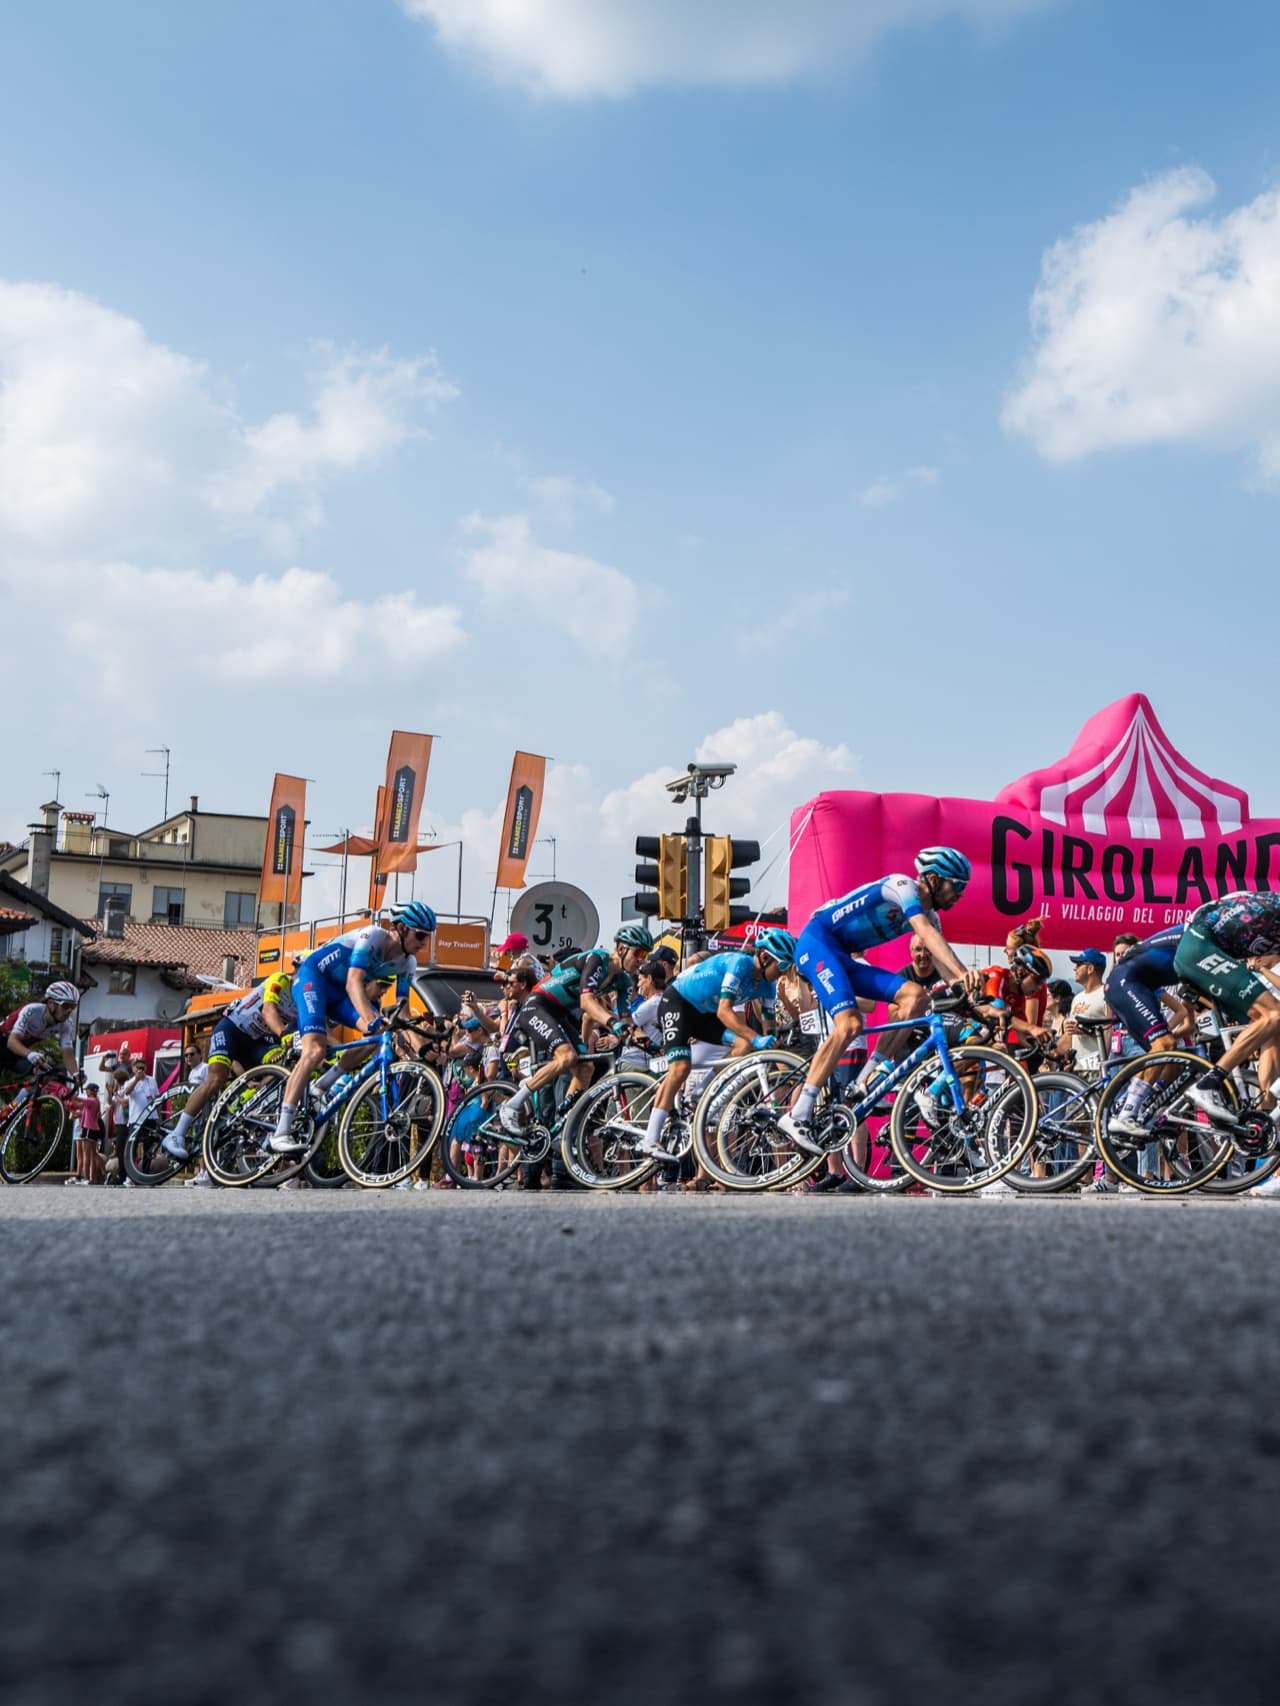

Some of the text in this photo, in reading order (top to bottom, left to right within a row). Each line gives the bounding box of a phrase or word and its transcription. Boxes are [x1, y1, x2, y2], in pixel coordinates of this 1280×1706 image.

[832, 894, 869, 924] GIANT
[1039, 903, 1051, 919] IL
[1061, 904, 1124, 923] VILLAGGIO
[1133, 905, 1154, 924] DEL
[664, 1011, 679, 1041] eolo
[801, 1014, 816, 1032] 185
[1135, 1002, 1159, 1026] VINYL
[528, 1015, 554, 1040] BORA
[907, 1050, 964, 1093] CADX
